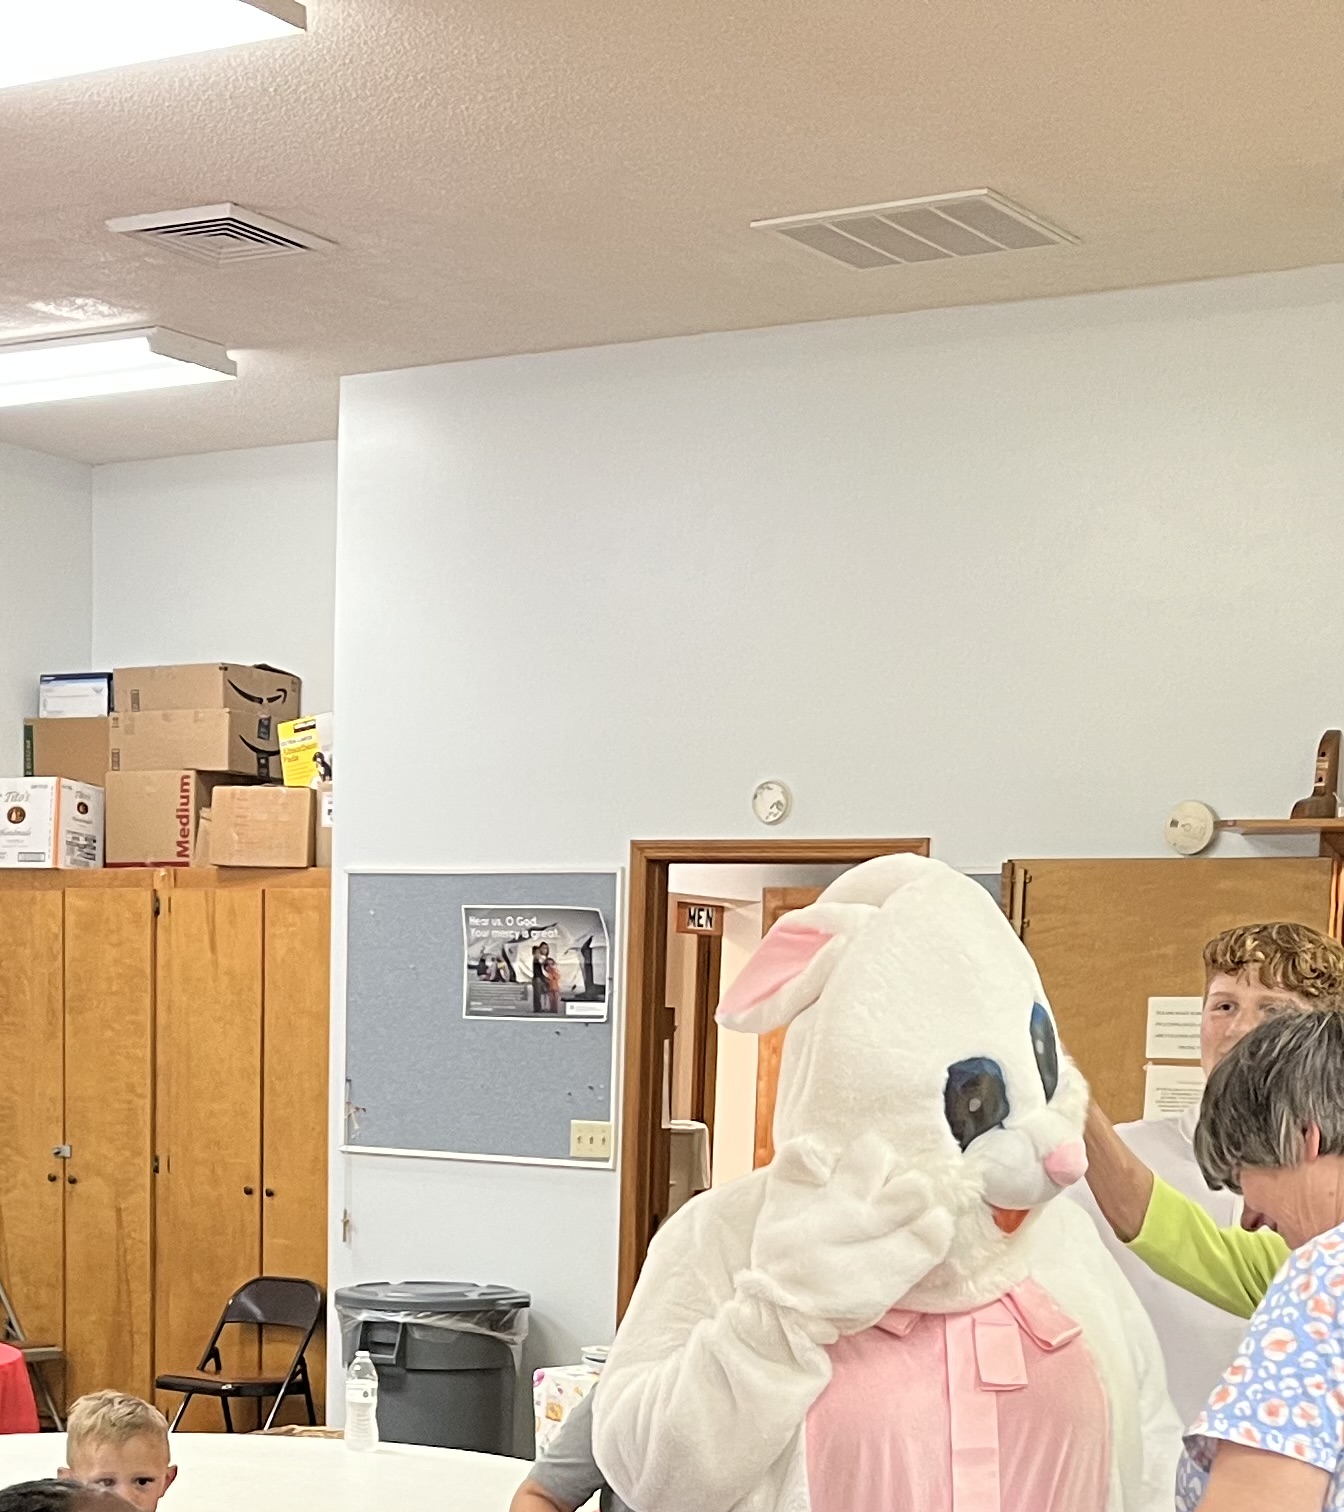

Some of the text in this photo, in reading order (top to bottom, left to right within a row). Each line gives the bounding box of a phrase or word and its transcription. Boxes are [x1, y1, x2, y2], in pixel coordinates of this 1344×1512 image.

[4, 790, 32, 803] Tito's
[175, 774, 191, 859] Medium
[468, 915, 490, 926] Hear
[505, 915, 515, 927] O
[687, 906, 714, 928] MEN
[470, 927, 490, 938] Your
[491, 929, 521, 941] mercy
